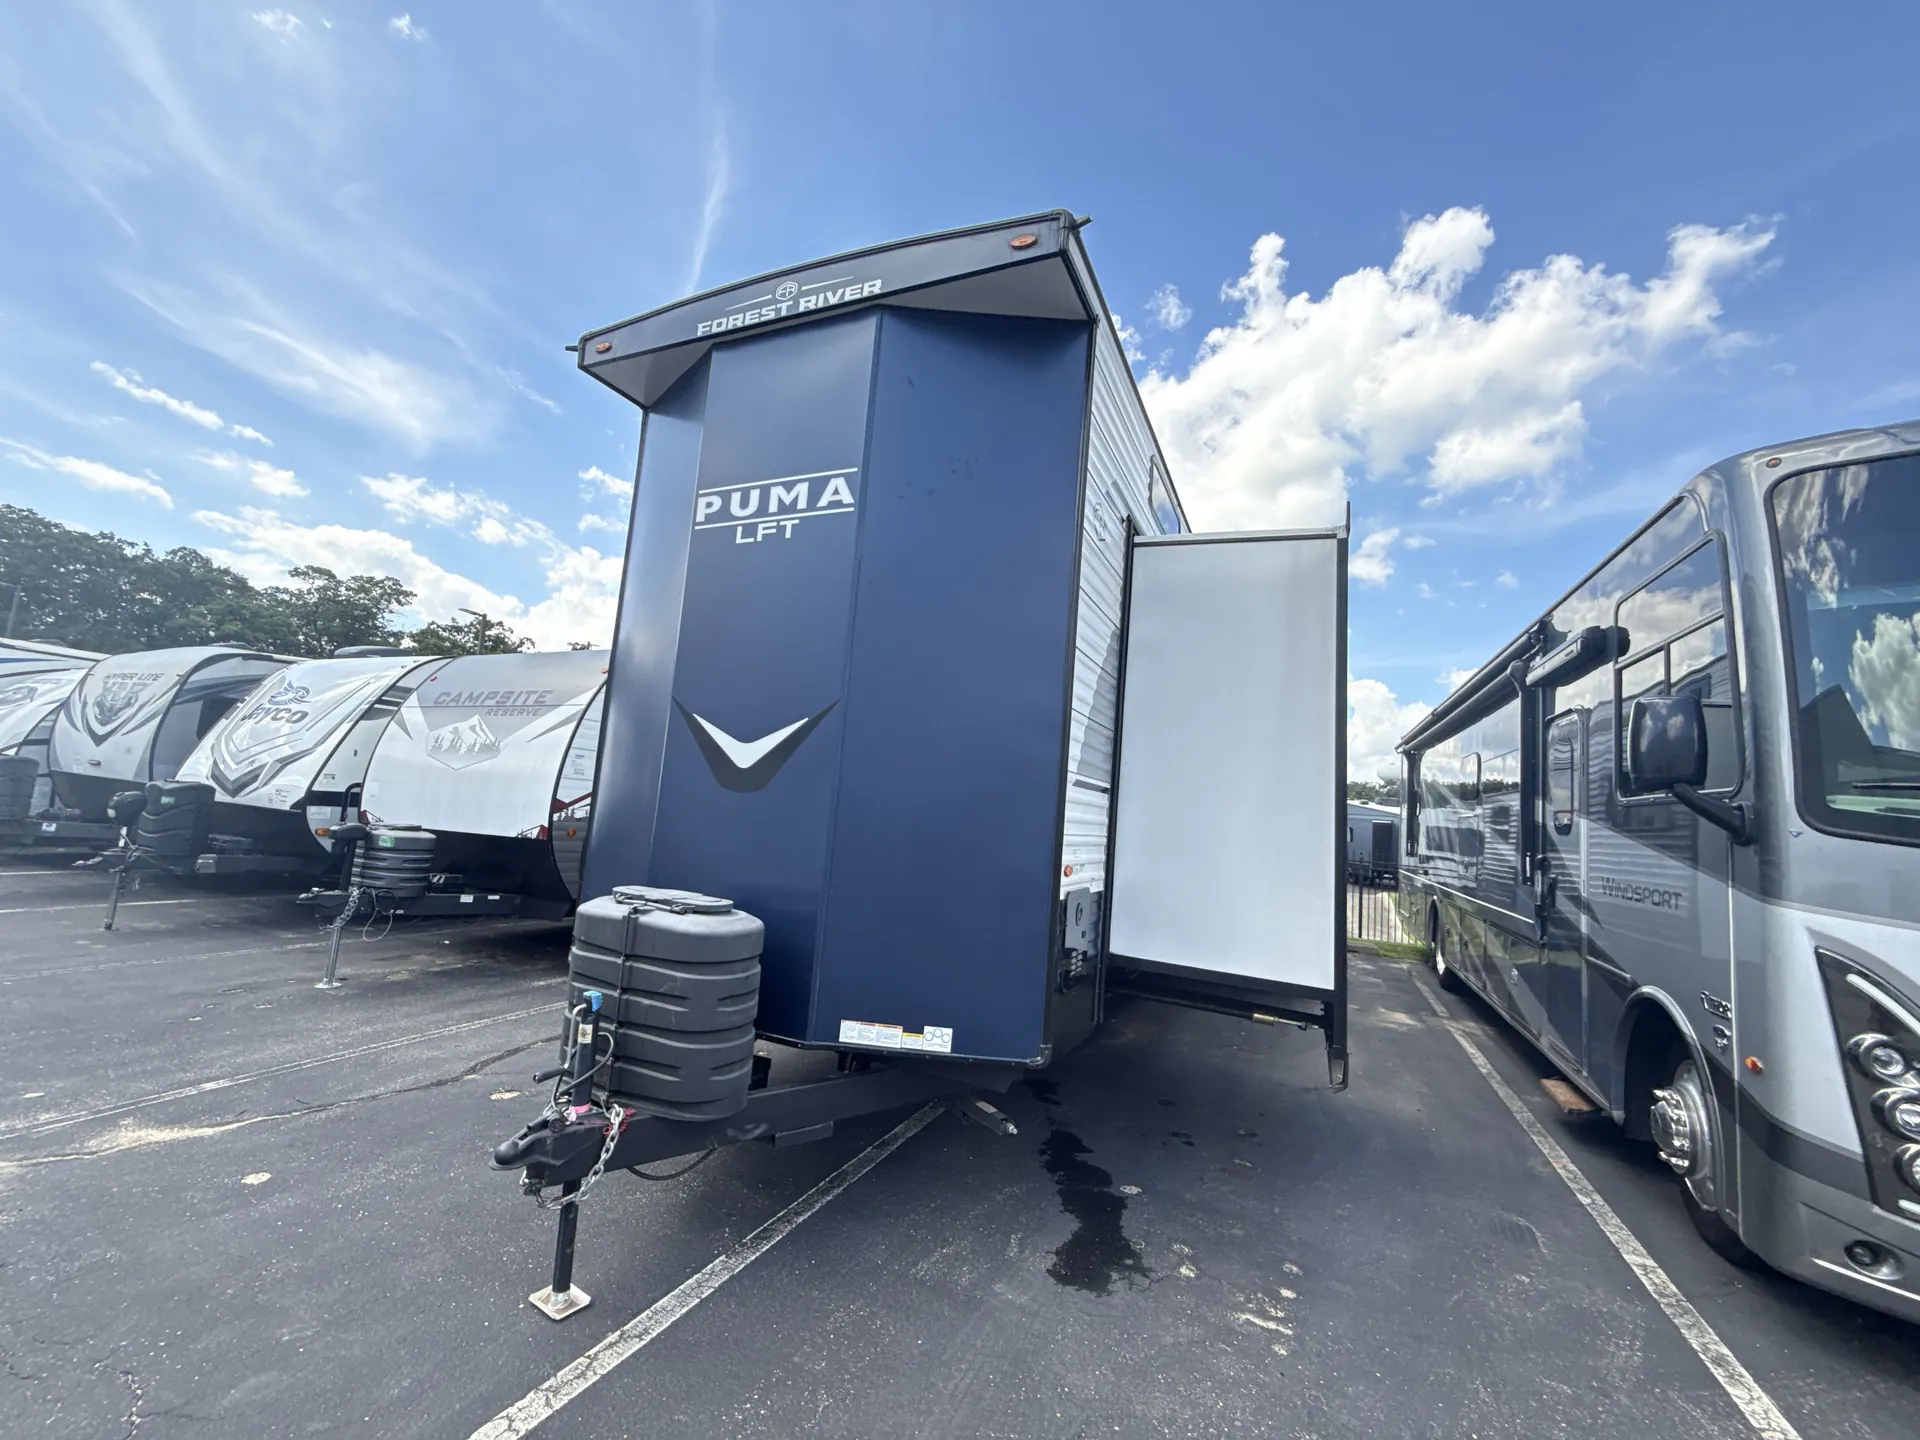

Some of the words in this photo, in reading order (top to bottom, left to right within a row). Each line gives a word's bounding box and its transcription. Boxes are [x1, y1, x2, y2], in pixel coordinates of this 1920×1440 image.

[697, 301, 793, 336] FOREST
[799, 279, 882, 312] RIVER
[695, 476, 855, 523] PUMA
[735, 519, 800, 544] LFT
[103, 673, 138, 682] HYPER
[137, 673, 164, 682] LITE
[432, 690, 554, 706] CAMPSITE
[240, 703, 309, 725] Jayco
[484, 708, 542, 717] RESERVE
